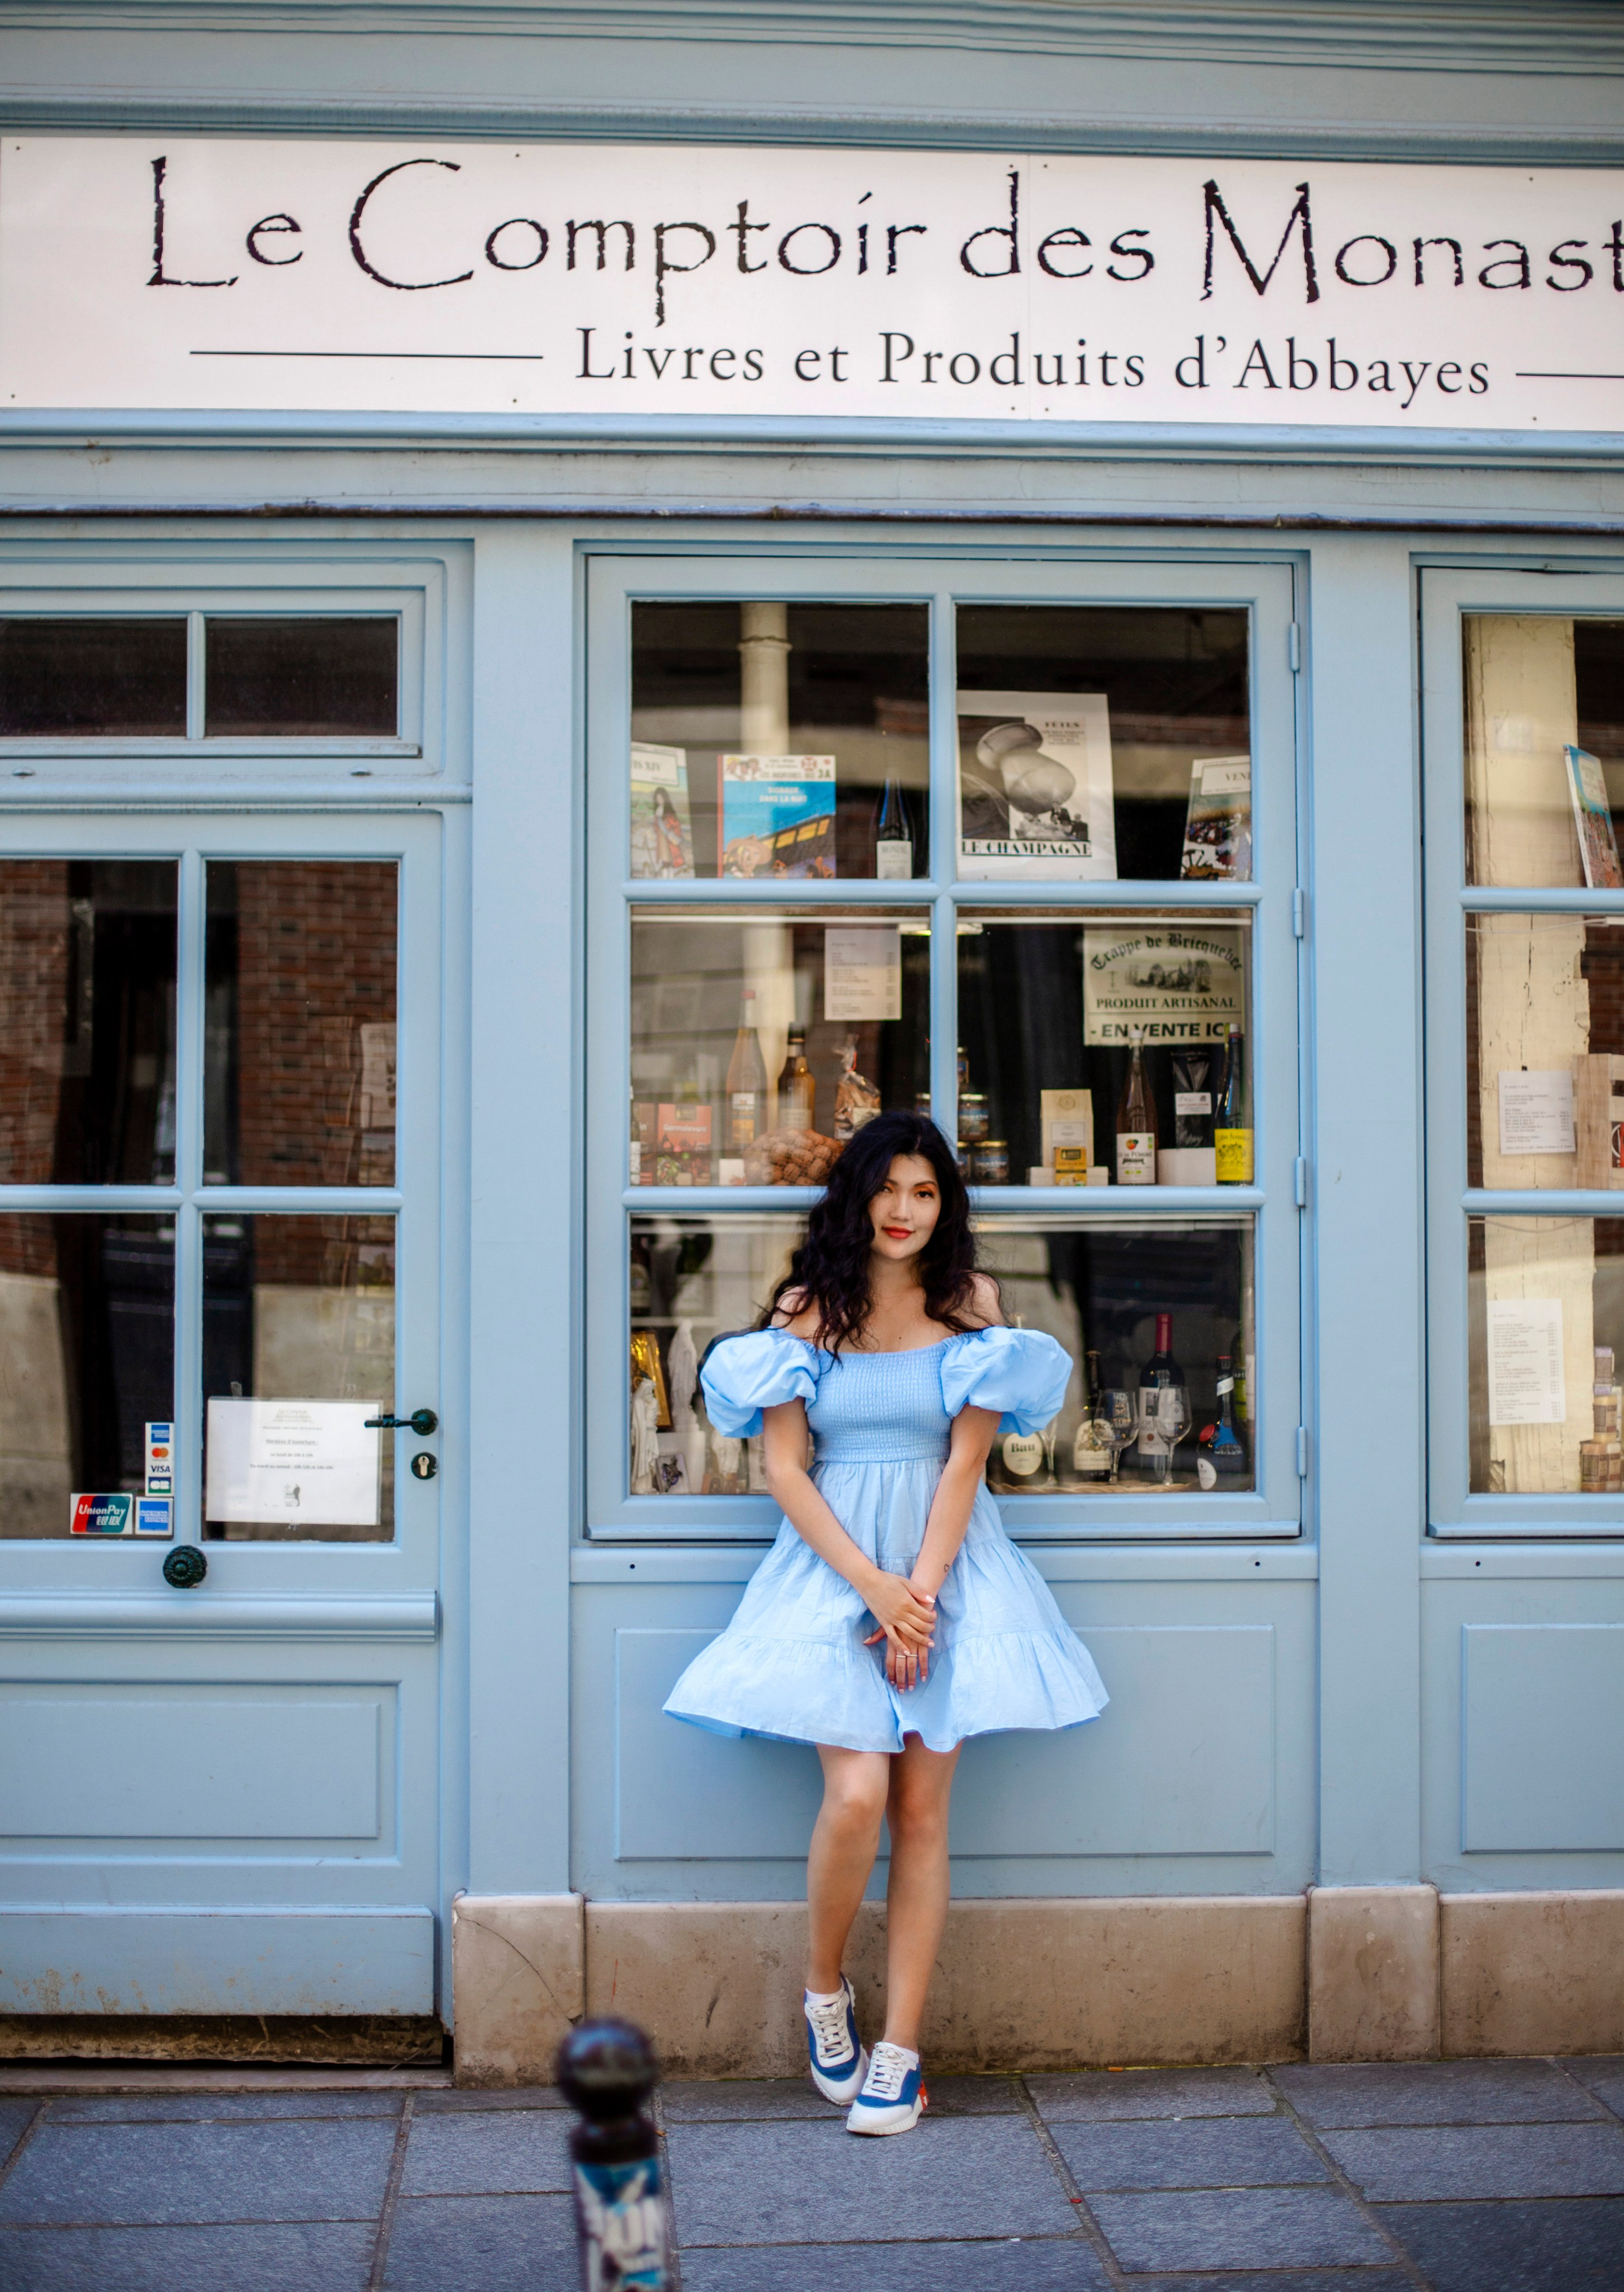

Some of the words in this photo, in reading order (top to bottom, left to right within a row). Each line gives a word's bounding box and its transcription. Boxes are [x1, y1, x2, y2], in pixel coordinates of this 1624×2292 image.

[147, 157, 302, 286] Le
[350, 159, 927, 326] Comptoir
[960, 172, 1155, 280] des
[576, 327, 762, 381] Livres
[795, 347, 848, 382] et
[879, 332, 1144, 386] Produits
[962, 841, 980, 853] LE
[986, 842, 1091, 855] CHAMPAGNE
[1091, 939, 1141, 970] Trappe
[1145, 935, 1162, 948] de
[1097, 998, 1158, 1008] PRODUIT
[1162, 997, 1236, 1008] ARTISANAL
[1101, 1024, 1129, 1037] EN
[78, 1504, 126, 1516] UnionPay
